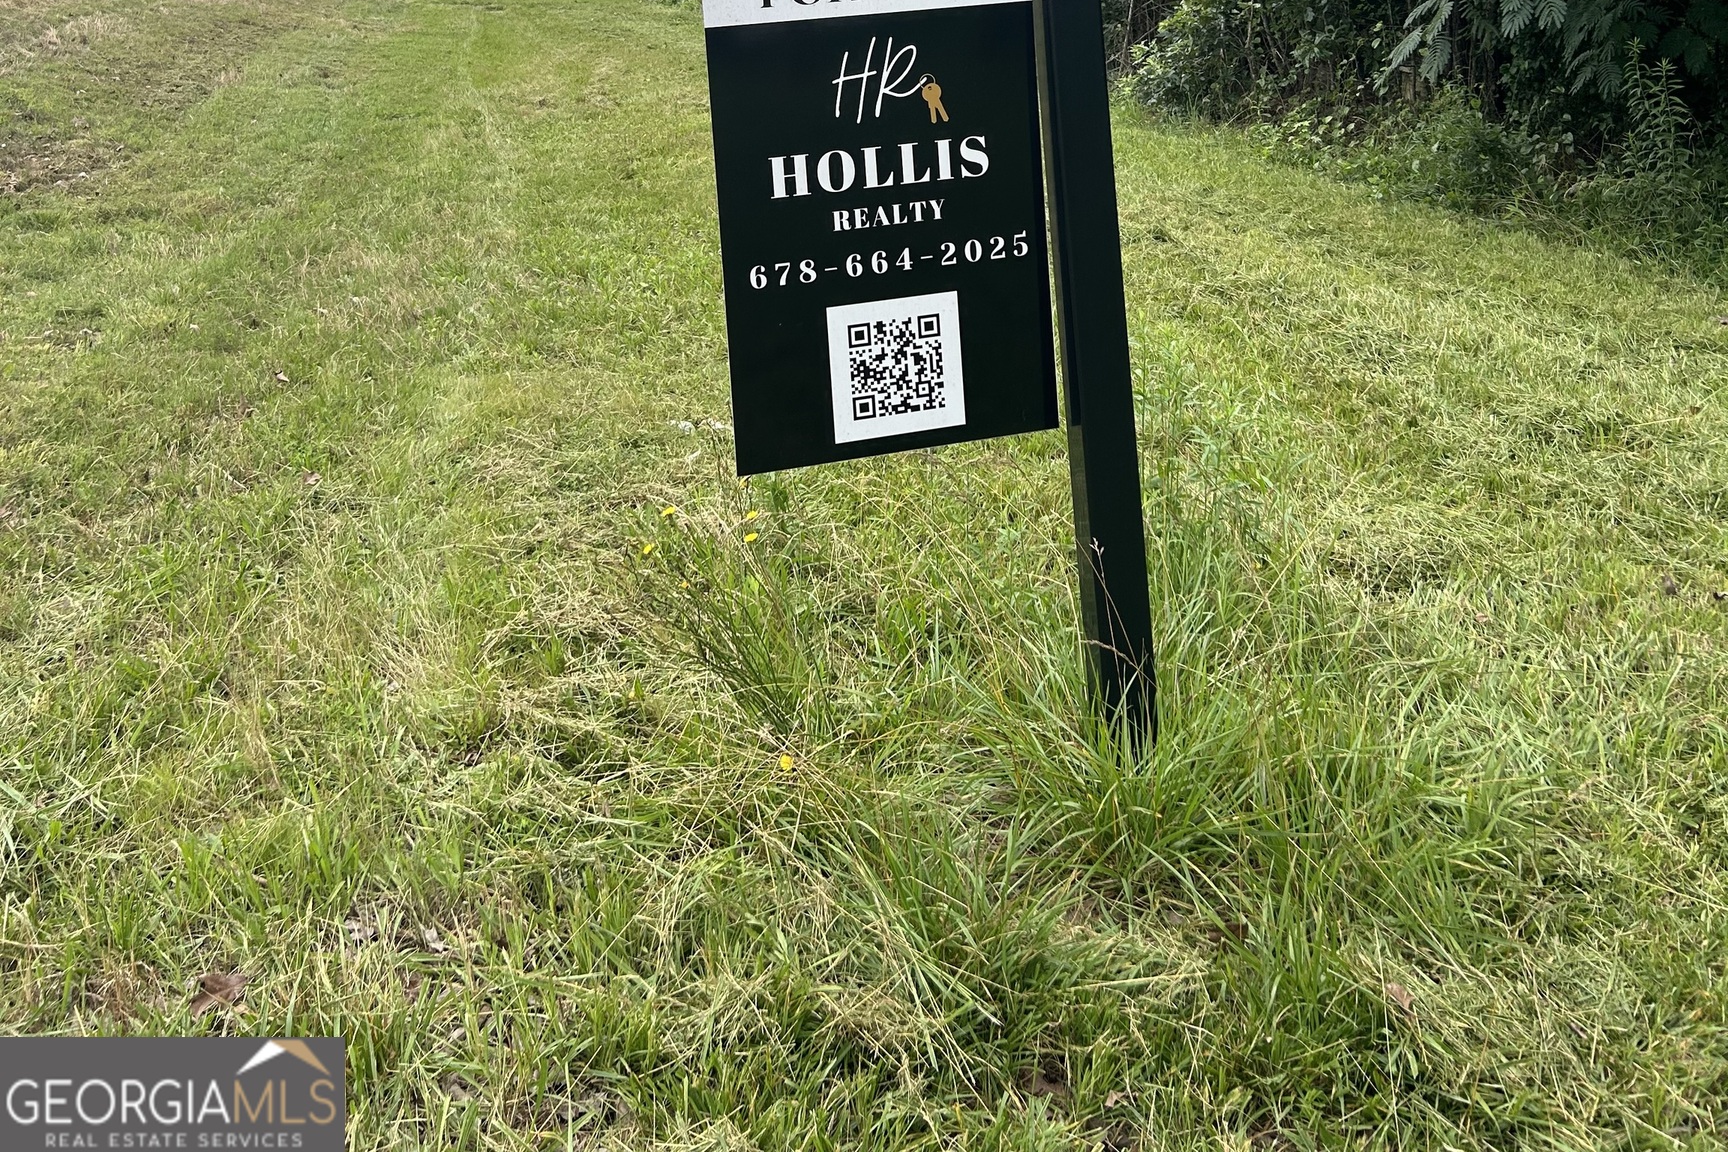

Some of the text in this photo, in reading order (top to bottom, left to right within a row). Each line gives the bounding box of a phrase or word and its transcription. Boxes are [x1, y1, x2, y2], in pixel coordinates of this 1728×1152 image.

[767, 135, 990, 200] HOLLIS
[831, 199, 945, 232] REALTY
[749, 230, 1030, 290] 678-664-2025
